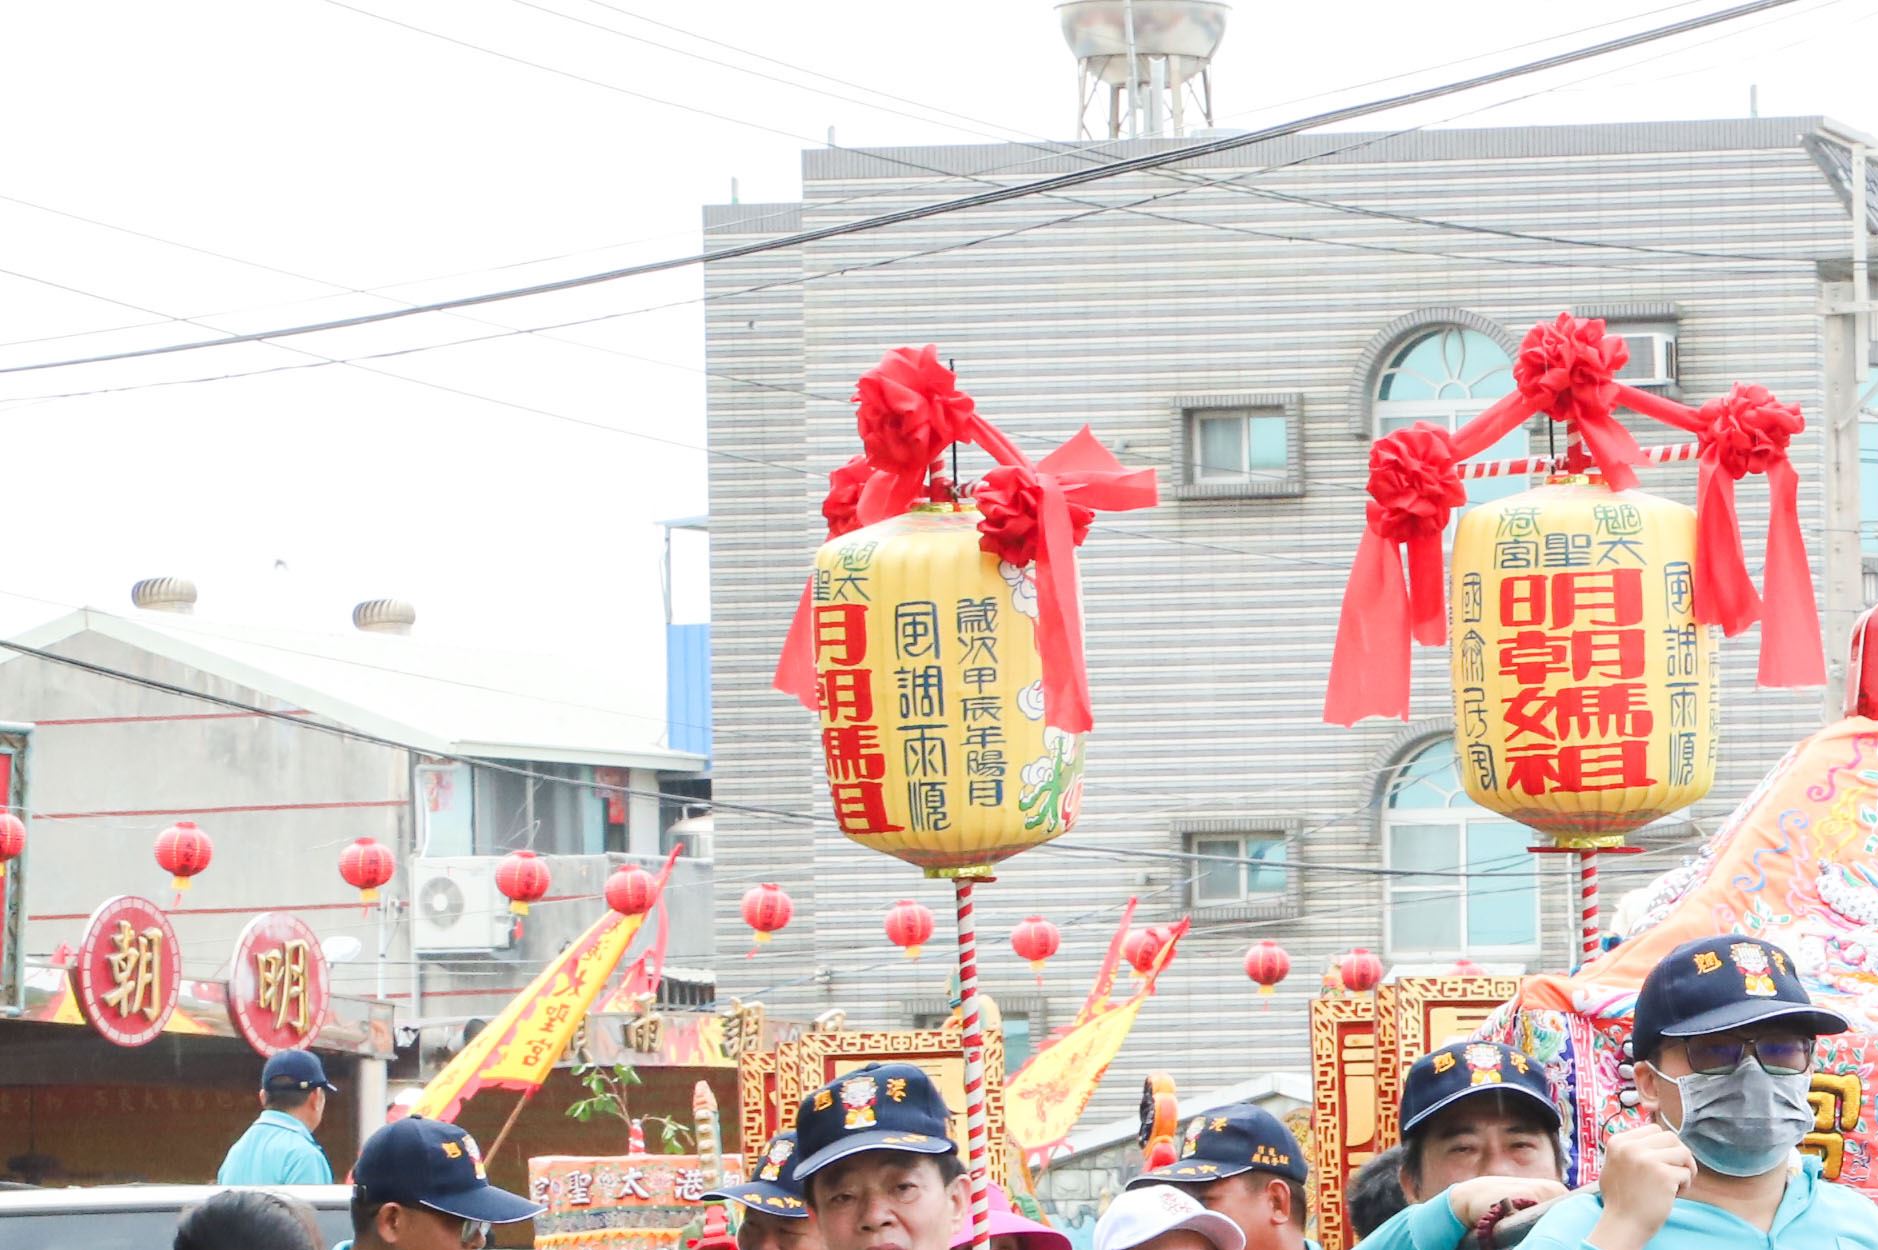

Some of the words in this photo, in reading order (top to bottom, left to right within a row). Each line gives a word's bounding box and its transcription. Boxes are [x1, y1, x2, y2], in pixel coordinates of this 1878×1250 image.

[893, 600, 952, 833] 風調雨順
[1496, 567, 1659, 797] 明朝媽祖
[1662, 560, 1700, 787] 風調雨順
[100, 918, 164, 1023] 朝
[256, 938, 310, 1036] 明
